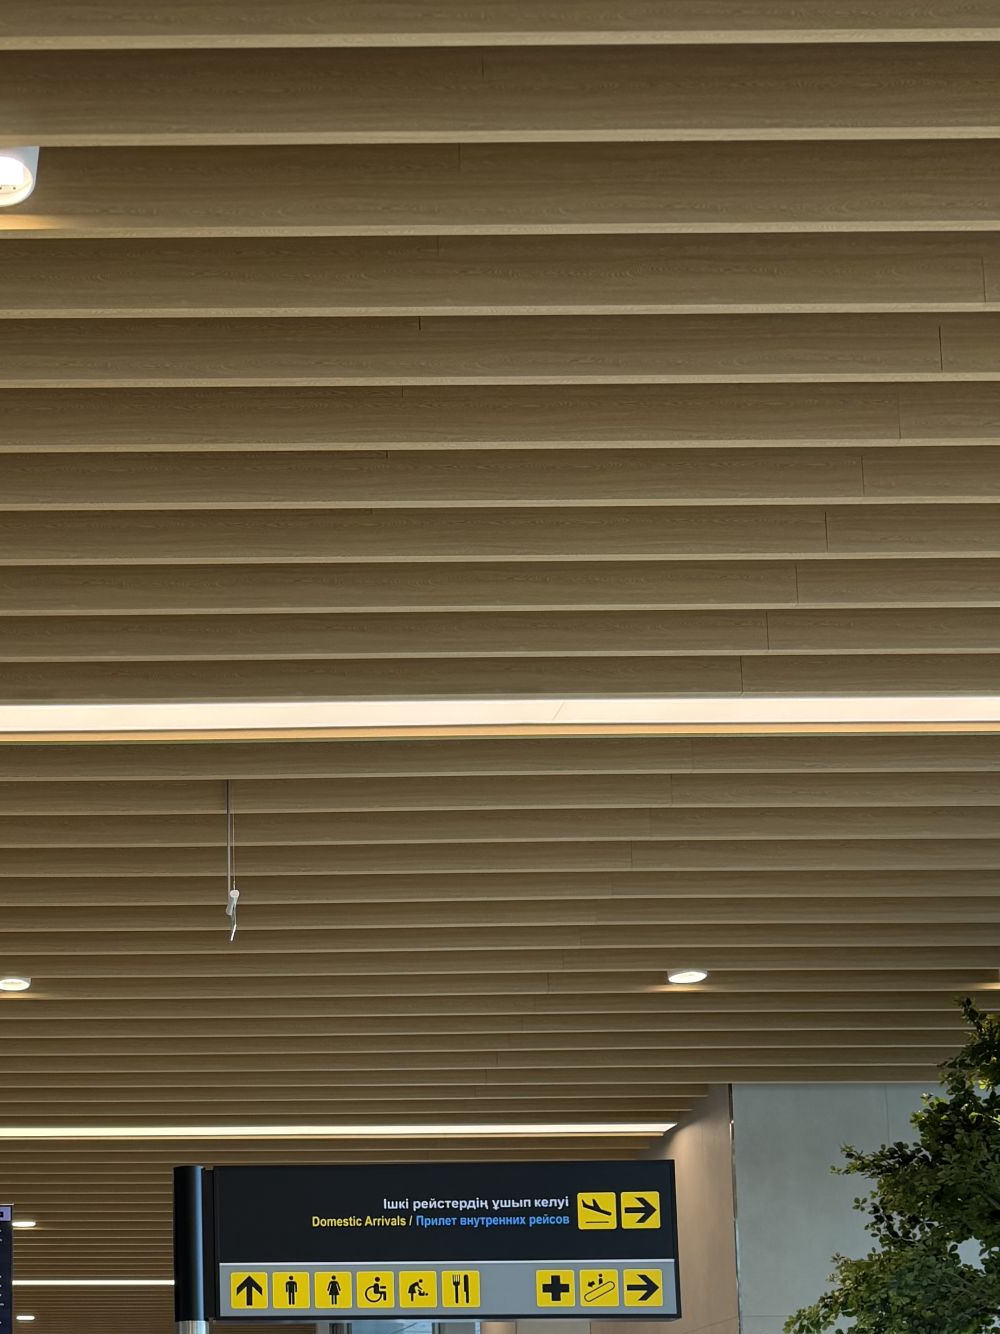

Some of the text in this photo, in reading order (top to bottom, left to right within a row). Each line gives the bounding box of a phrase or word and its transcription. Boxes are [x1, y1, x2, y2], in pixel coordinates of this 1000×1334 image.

[383, 1196, 569, 1212] Ішкі рейстердің ұшып келуі
[312, 1215, 362, 1227] Domestic
[364, 1215, 407, 1227] Arrivals
[416, 1215, 457, 1227] Прилет
[460, 1216, 526, 1227] внутренних
[529, 1214, 570, 1227] рейсов
